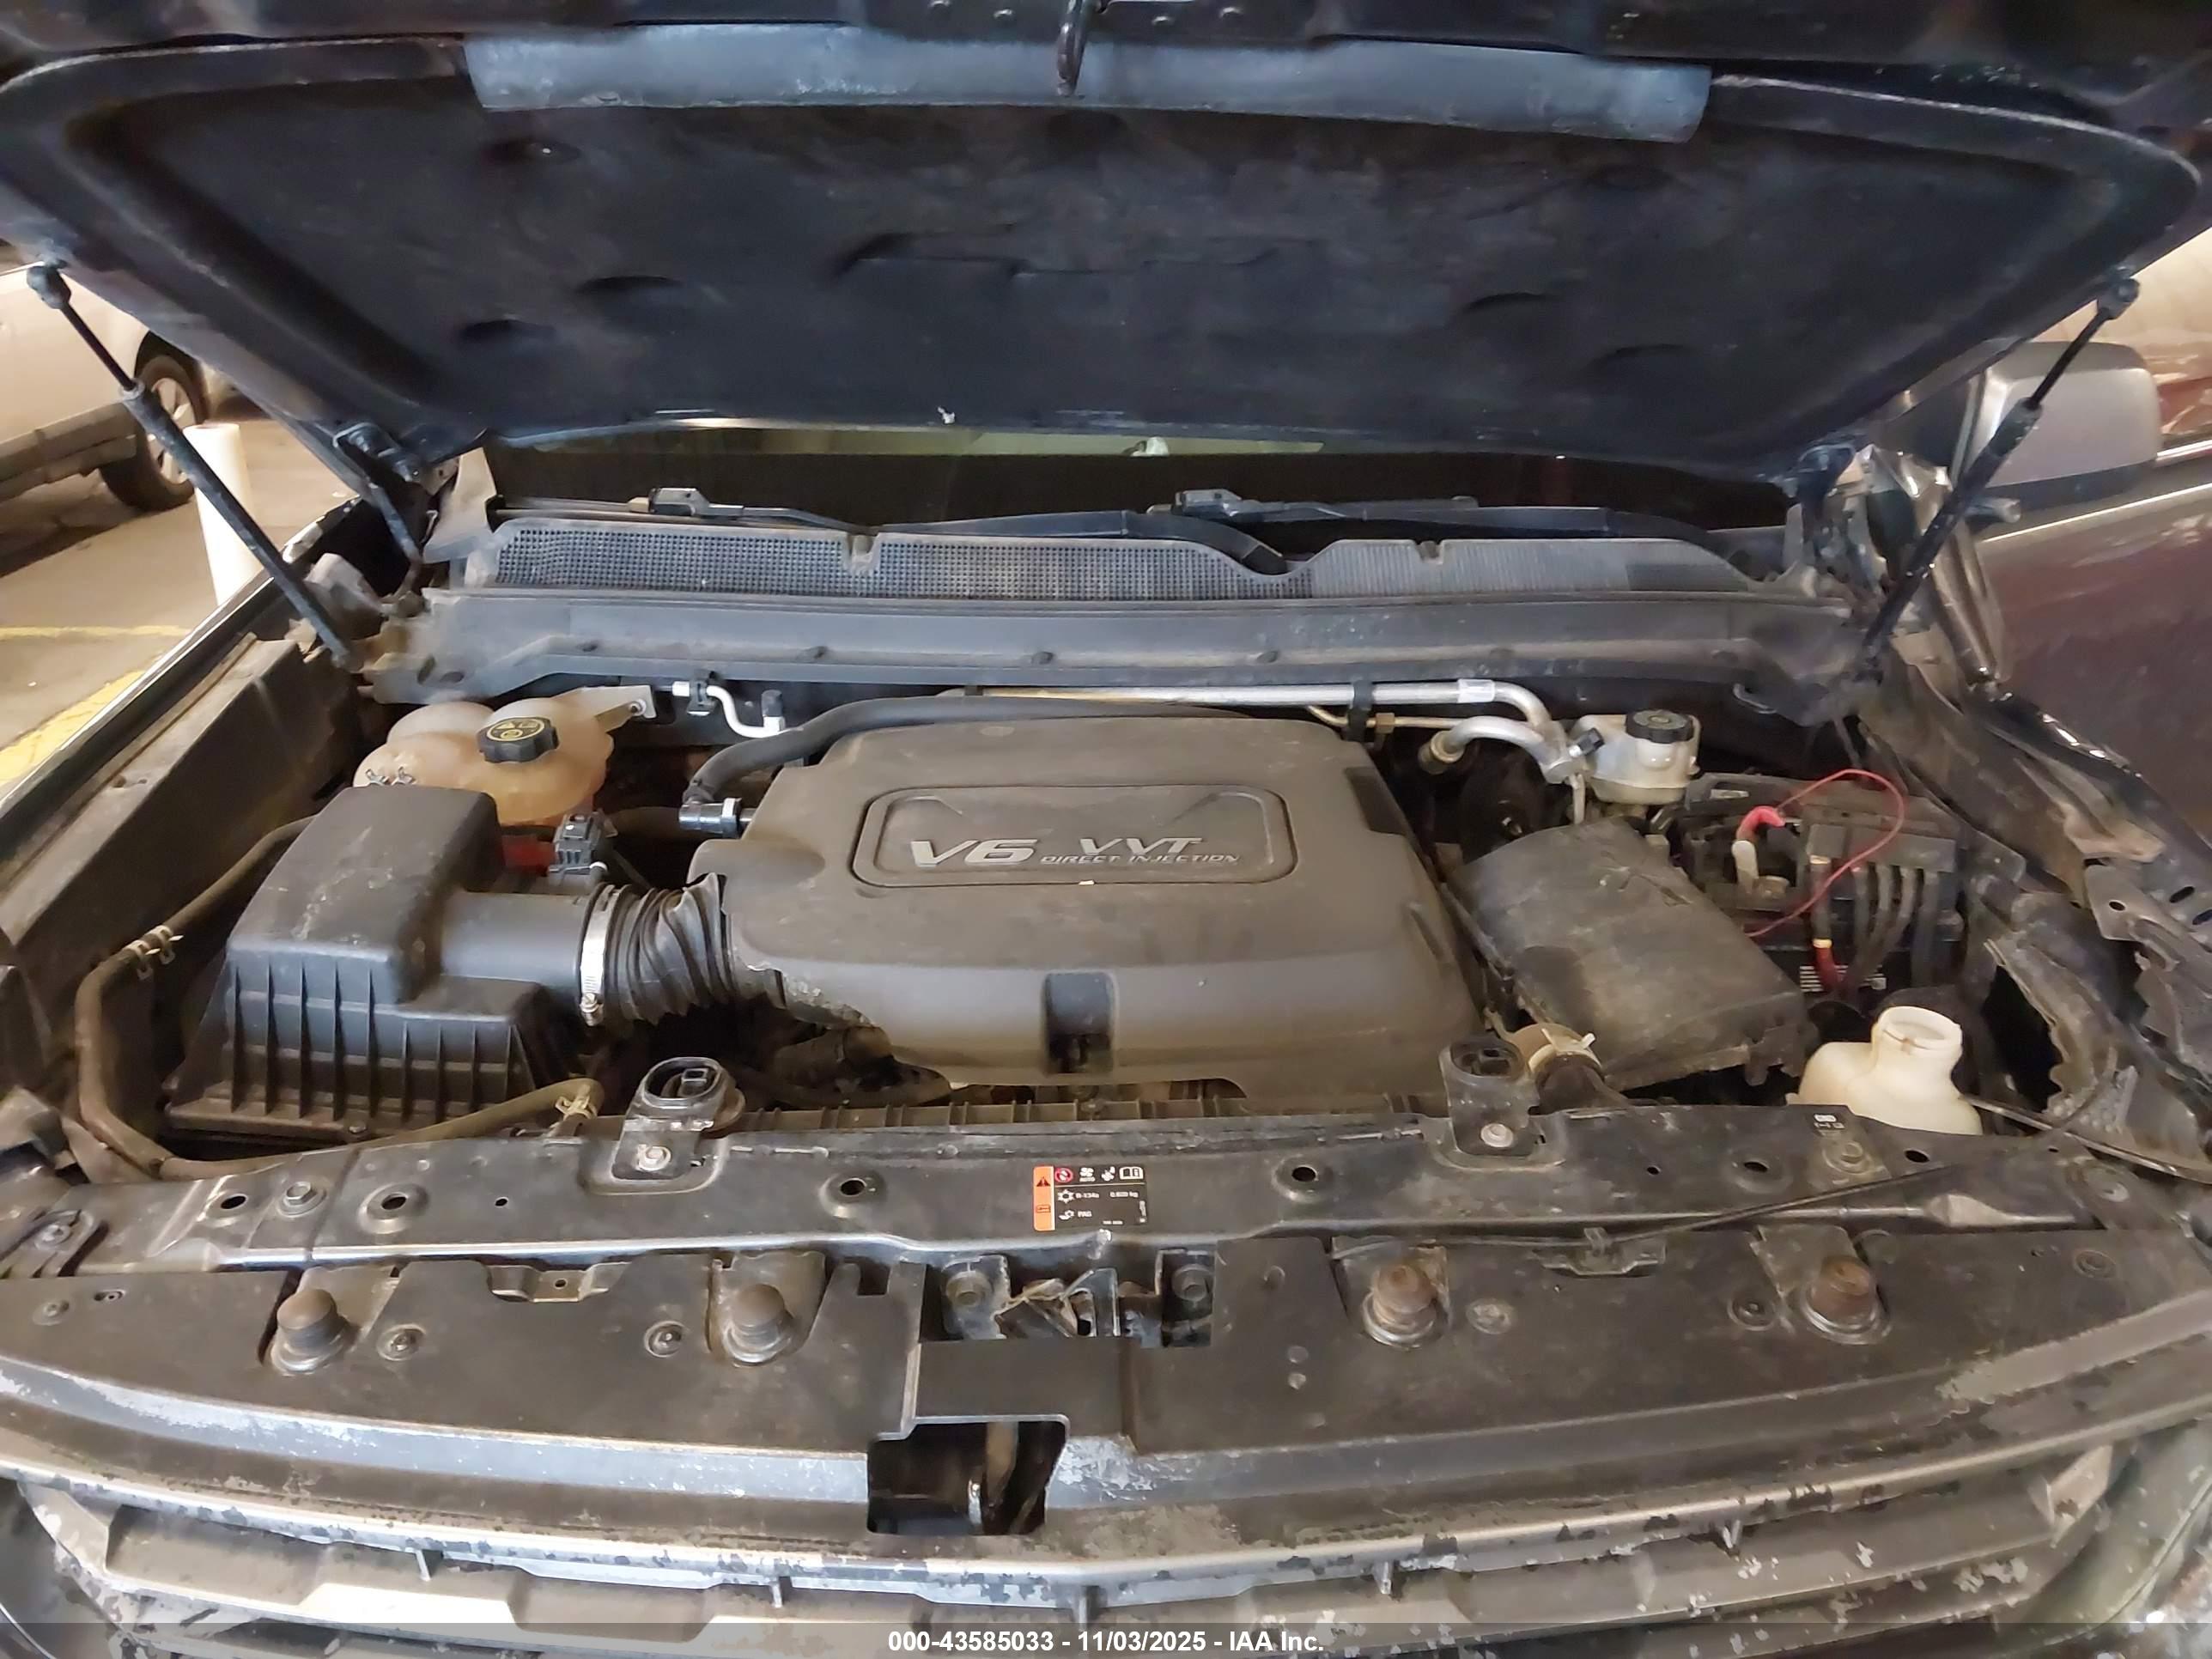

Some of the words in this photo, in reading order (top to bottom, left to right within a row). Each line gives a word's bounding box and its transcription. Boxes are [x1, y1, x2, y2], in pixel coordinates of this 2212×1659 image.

[911, 839, 1037, 867] V6
[1079, 837, 1202, 855] VVT
[1040, 855, 1120, 864] DIRECT
[1128, 854, 1238, 865] INJECTION
